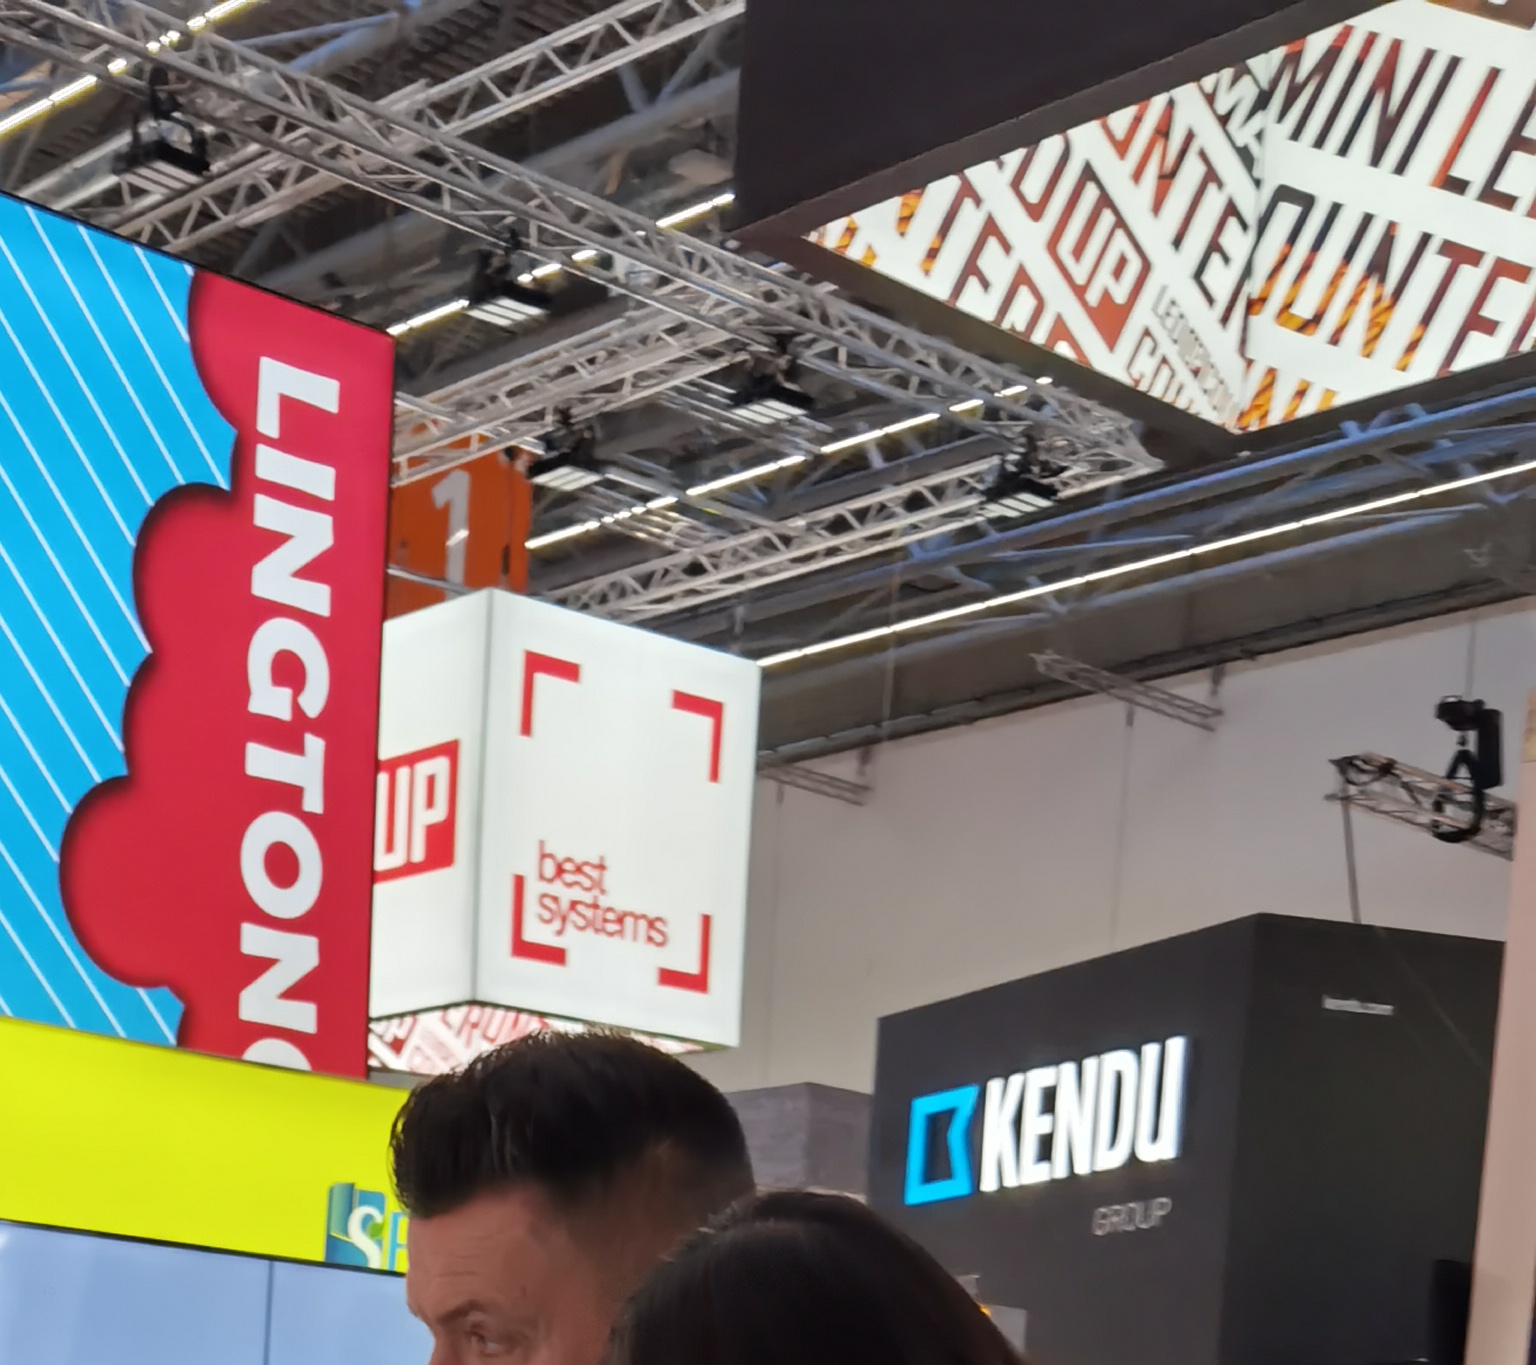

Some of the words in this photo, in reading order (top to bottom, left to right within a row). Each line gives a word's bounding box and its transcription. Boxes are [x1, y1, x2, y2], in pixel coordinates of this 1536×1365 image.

[537, 839, 609, 897] best
[536, 890, 669, 949] systems
[978, 1034, 1190, 1193] KENDU
[1091, 1196, 1173, 1237] GROUP
